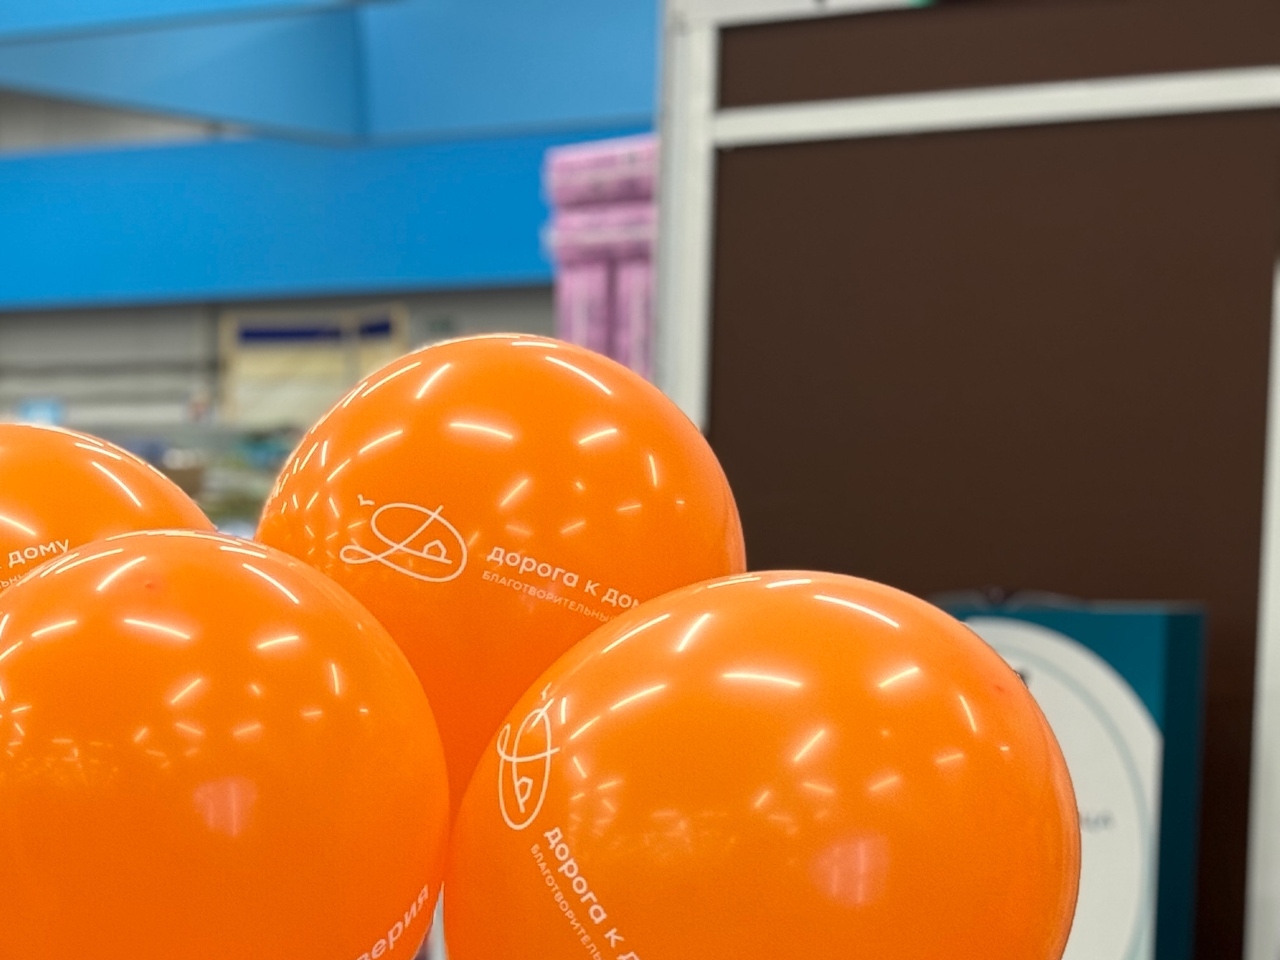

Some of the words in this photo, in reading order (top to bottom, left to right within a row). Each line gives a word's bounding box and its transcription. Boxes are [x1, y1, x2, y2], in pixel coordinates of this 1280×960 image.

[8, 539, 69, 568] дому
[487, 546, 579, 587] дорога
[584, 580, 600, 596] к
[601, 588, 639, 610] до
[482, 570, 613, 622] БЛАГОТВОРИТЕЛЬНЫ
[544, 827, 607, 924] дорога
[604, 928, 624, 948] к
